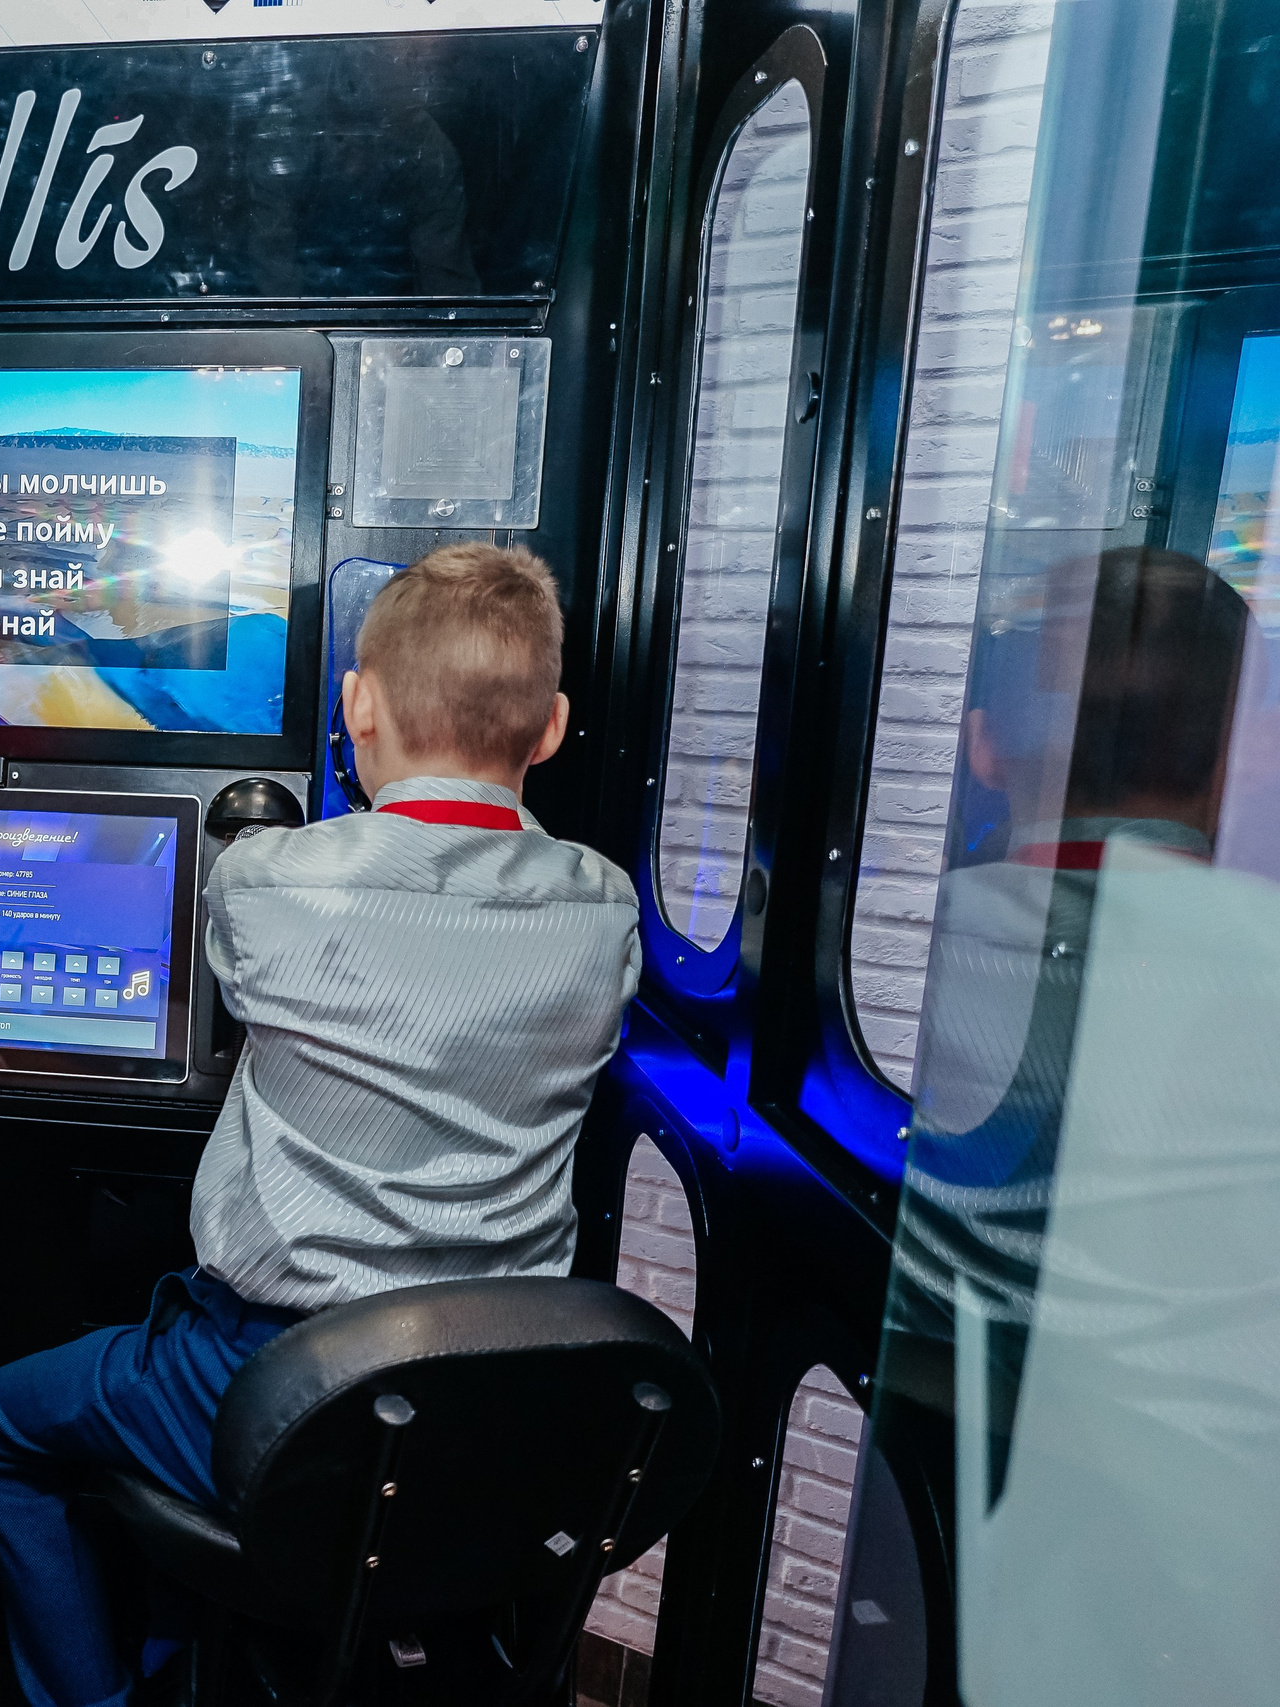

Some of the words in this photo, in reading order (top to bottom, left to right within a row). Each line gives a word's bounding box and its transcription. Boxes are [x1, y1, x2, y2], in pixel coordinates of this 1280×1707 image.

[21, 472, 167, 496] молчишь
[16, 515, 115, 549] пойму
[13, 562, 85, 591] знай
[6, 890, 27, 898] СИНИЕ
[28, 891, 48, 899] ГЛАЗА
[13, 911, 34, 919] ударов
[39, 913, 61, 921] минуту
